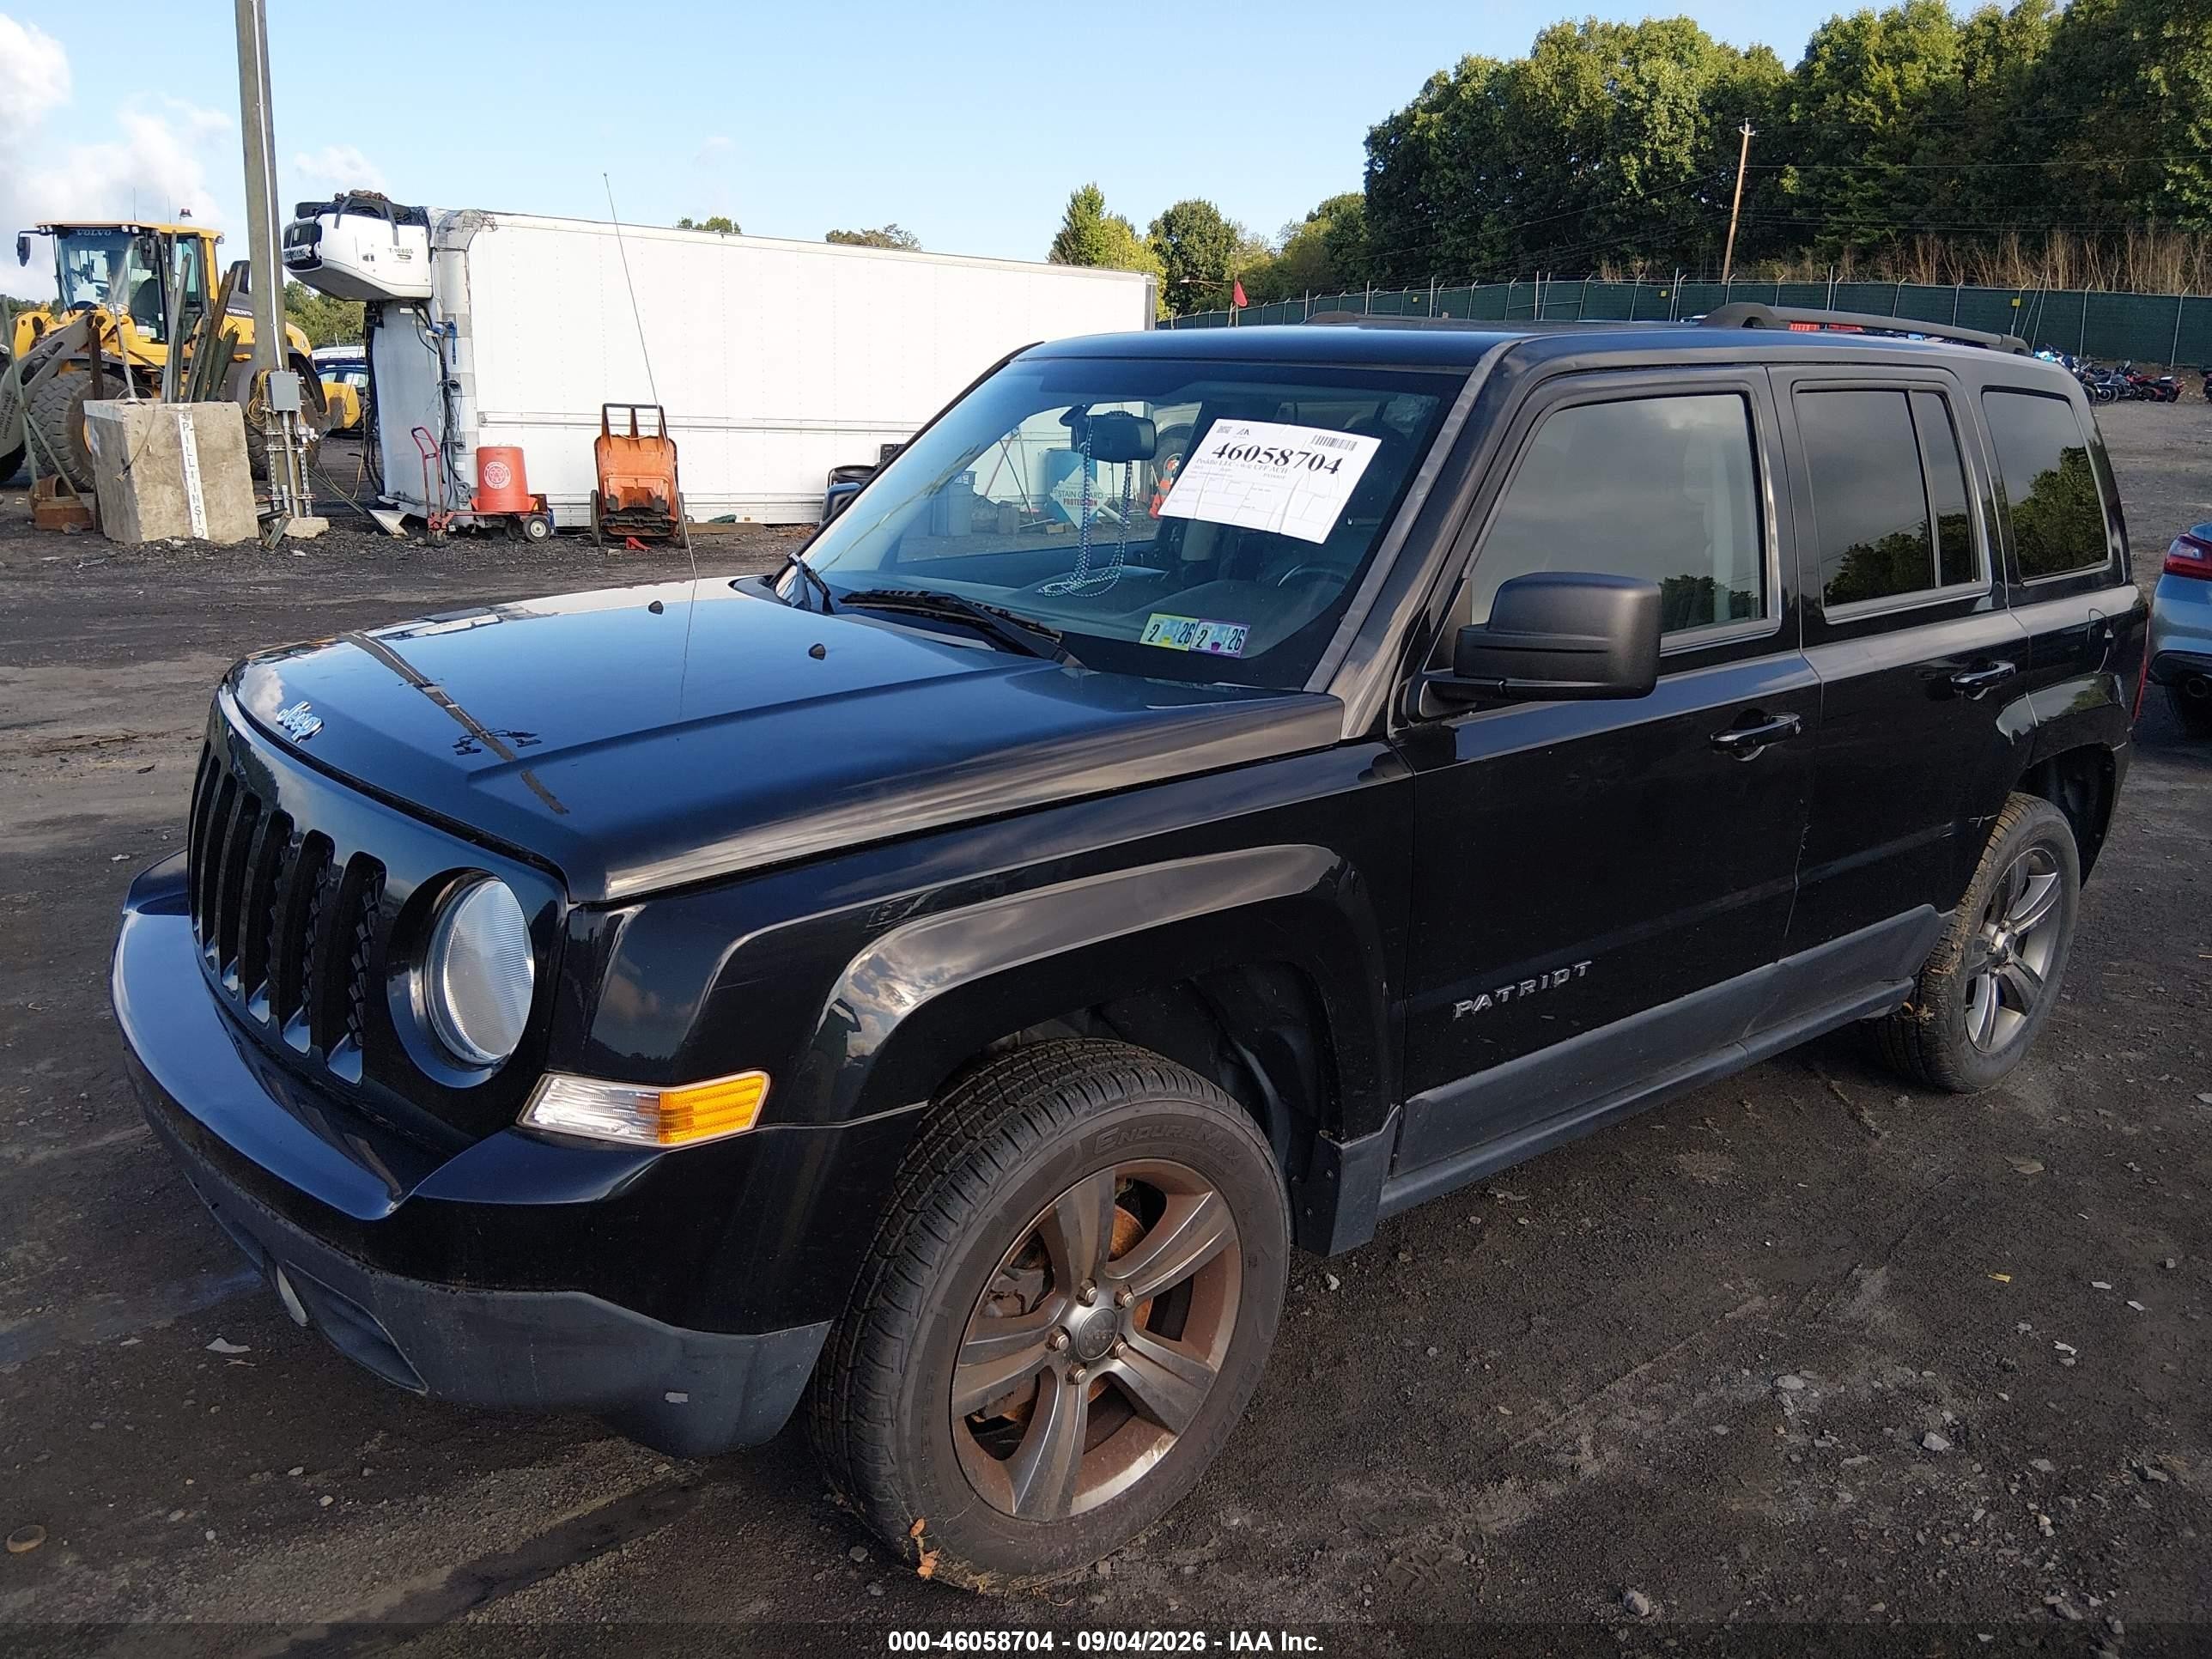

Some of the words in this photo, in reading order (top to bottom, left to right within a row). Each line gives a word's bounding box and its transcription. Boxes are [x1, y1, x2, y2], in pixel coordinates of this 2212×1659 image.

[226, 307, 253, 317] VOLVO
[1212, 442, 1343, 475] 46058704
[1058, 489, 1077, 498] STAIN
[1147, 624, 1160, 642] 2
[1177, 623, 1195, 644] 26
[1195, 629, 1208, 648] 2
[1227, 629, 1245, 650] 26
[275, 701, 322, 742] Jeep
[1453, 960, 1592, 1019] PATRIOT
